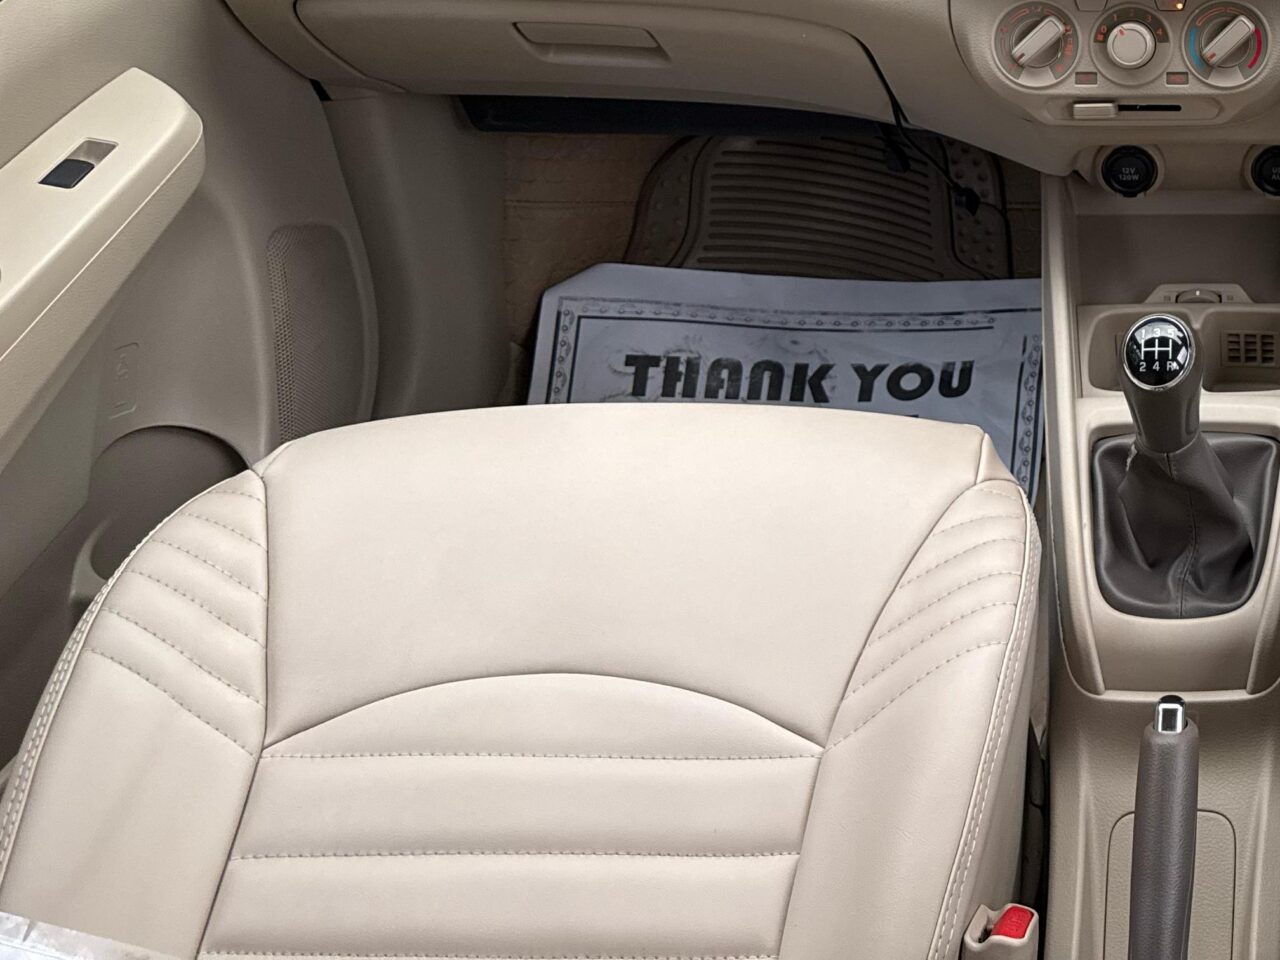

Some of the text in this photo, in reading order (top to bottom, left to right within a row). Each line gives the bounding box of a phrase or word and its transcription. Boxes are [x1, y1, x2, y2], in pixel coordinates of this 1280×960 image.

[1141, 327, 1175, 339] 1 3 5
[1139, 360, 1174, 372] 2 4 R
[625, 354, 975, 404] THANK YOU
